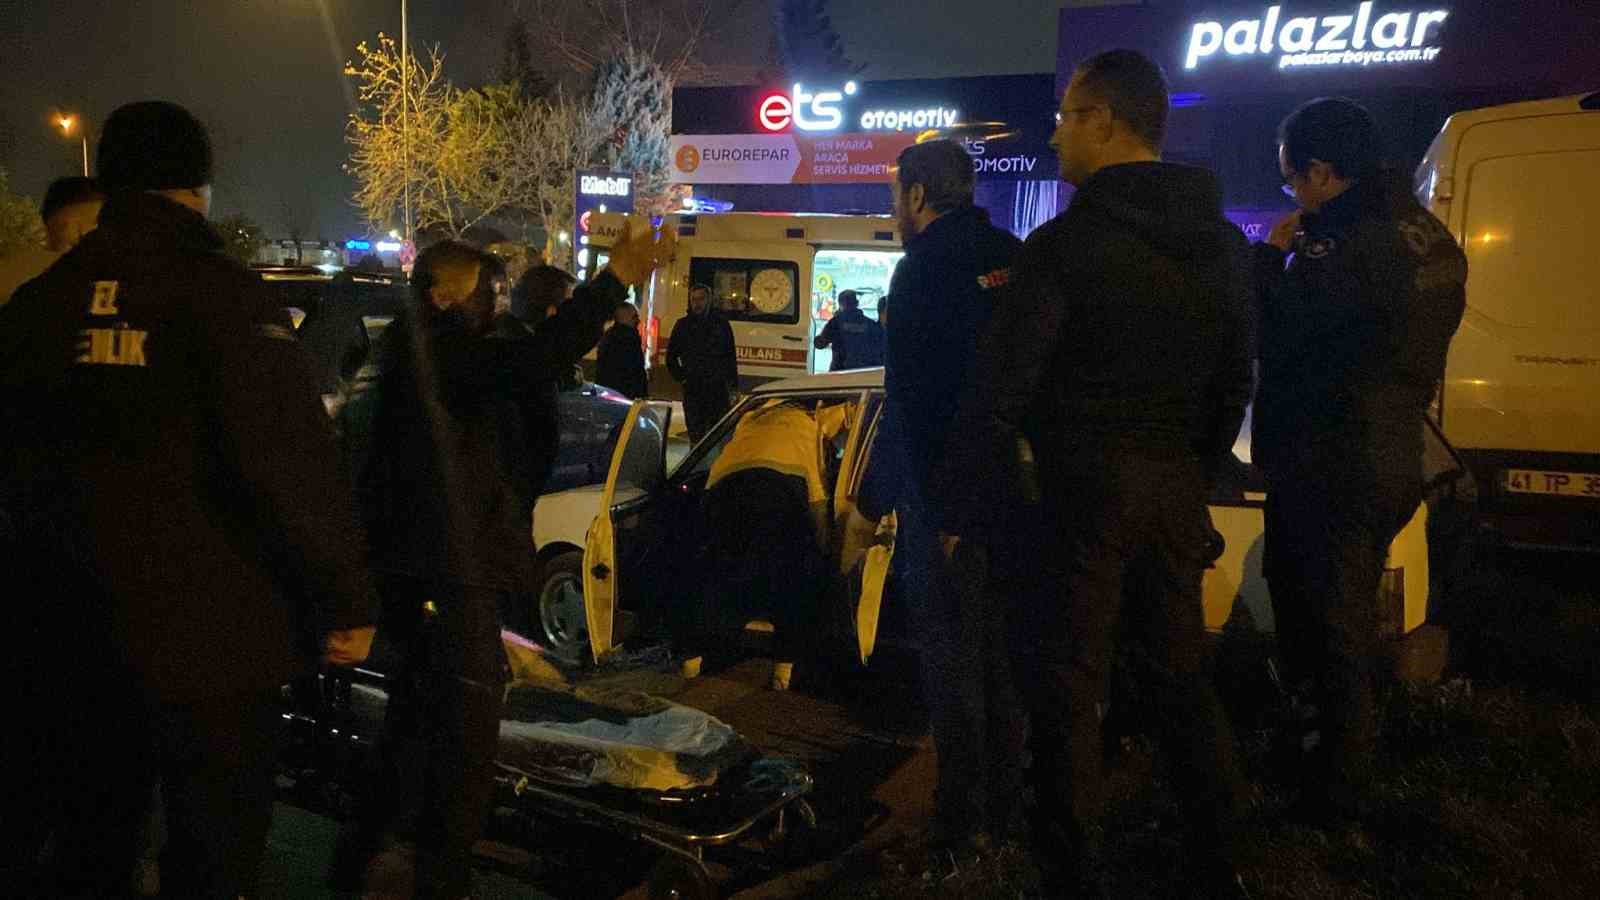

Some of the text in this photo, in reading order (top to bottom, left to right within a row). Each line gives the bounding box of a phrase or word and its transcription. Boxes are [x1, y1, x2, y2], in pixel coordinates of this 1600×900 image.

[1185, 1, 1449, 69] palazlar
[759, 82, 845, 132] ets
[860, 108, 957, 130] OTOMOTİV
[703, 148, 790, 161] EUROREPAR
[1511, 474, 1531, 490] 41
[1544, 474, 1570, 491] TP
